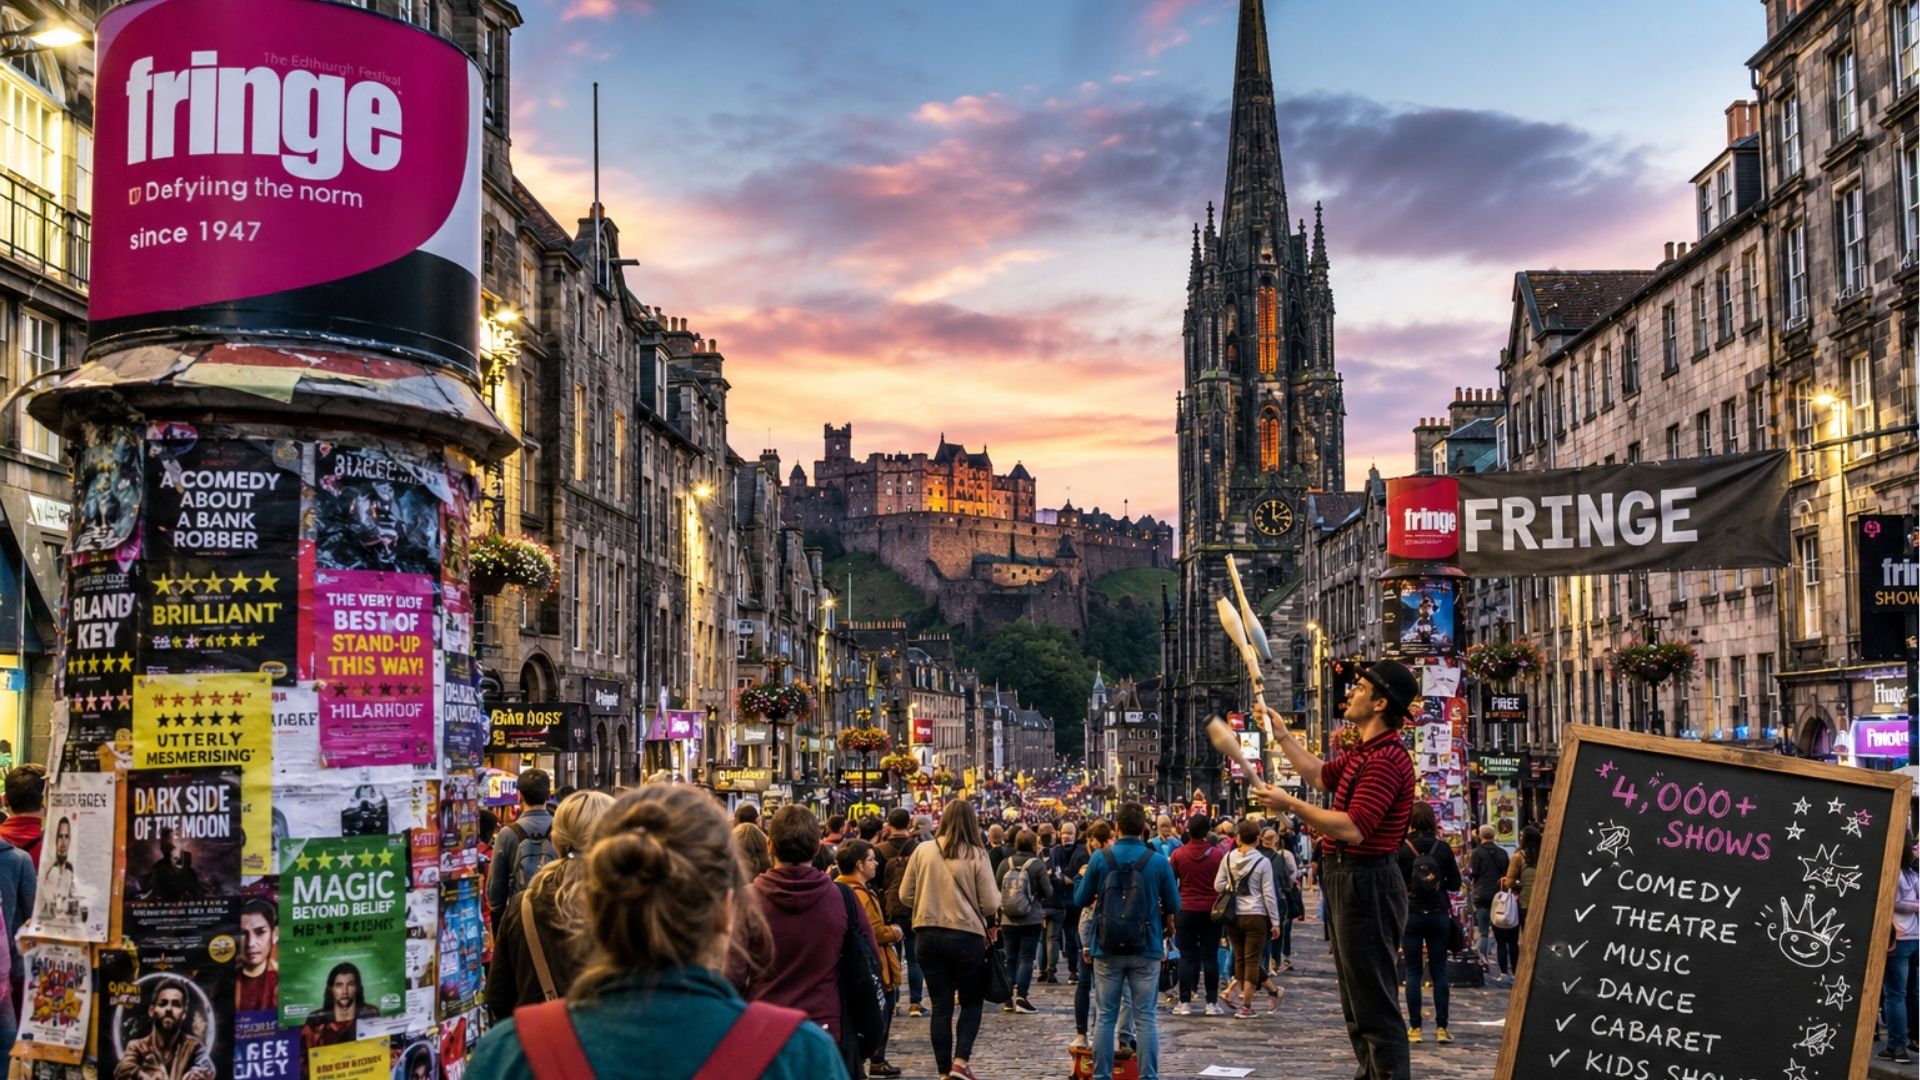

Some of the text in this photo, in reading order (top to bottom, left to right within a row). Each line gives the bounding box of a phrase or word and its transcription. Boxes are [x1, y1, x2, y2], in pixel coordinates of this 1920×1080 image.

[126, 50, 402, 181] fringe
[254, 176, 294, 199] the
[300, 183, 363, 208] norm
[129, 220, 262, 250] since 1947
[160, 470, 281, 491] A COMEDY
[180, 491, 255, 509] ABOUT
[176, 511, 256, 530] A BANK
[1404, 507, 1457, 534] fringe
[1464, 486, 1698, 553] FRINGE
[173, 530, 259, 549] ROBBER
[326, 593, 356, 606] THE
[358, 594, 393, 608] VERY
[333, 610, 419, 632] BEST OF
[76, 622, 120, 649] KEY
[332, 633, 421, 653] STAND-UP
[327, 655, 424, 676] THIS WAY!
[157, 731, 244, 747] UTTERLY
[134, 786, 182, 815] DARK
[185, 785, 230, 814] SIDE
[1612, 775, 1757, 819] 4,000+
[134, 816, 152, 840] OF
[181, 814, 230, 839] MOON
[1662, 820, 1772, 860] SHOWS
[1617, 869, 1742, 909] COMEDY
[292, 904, 350, 920] BEYOND
[1611, 905, 1739, 944] THEATRE
[1602, 941, 1692, 975] MUSIC
[1597, 978, 1696, 1014] DANCE
[1591, 1014, 1722, 1055] CABARET
[1585, 1049, 1650, 1080] KIDS
